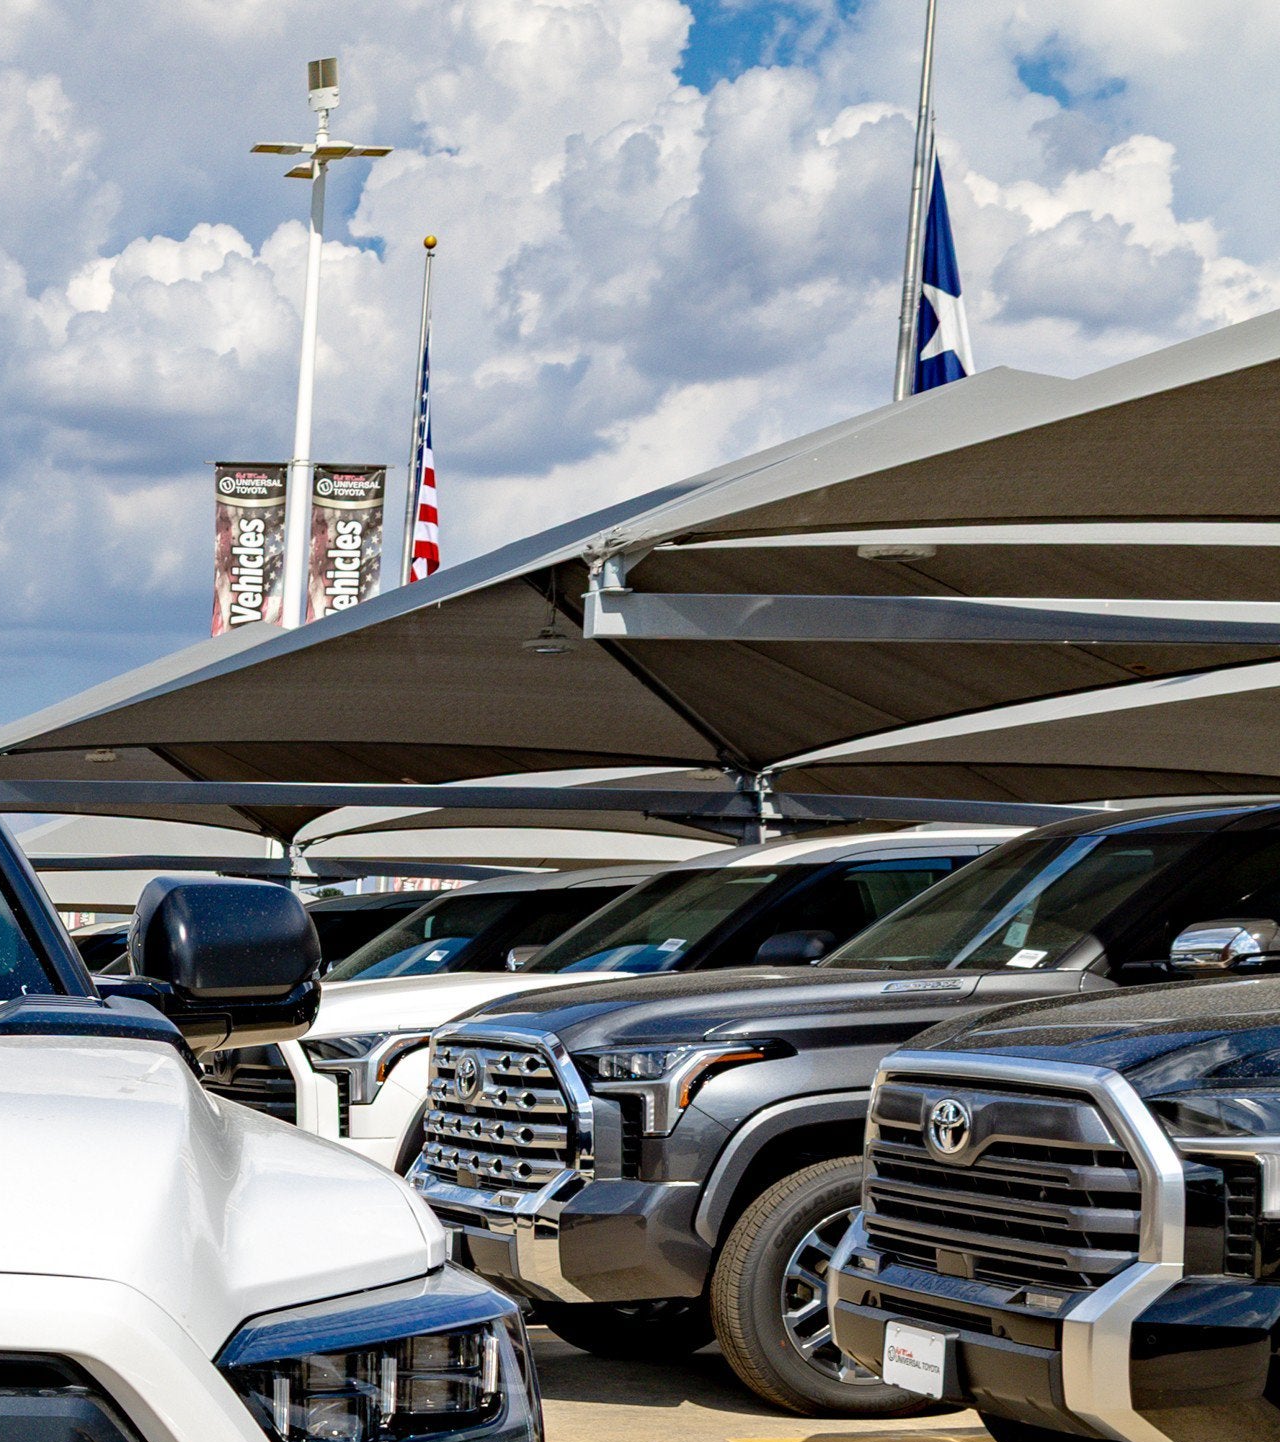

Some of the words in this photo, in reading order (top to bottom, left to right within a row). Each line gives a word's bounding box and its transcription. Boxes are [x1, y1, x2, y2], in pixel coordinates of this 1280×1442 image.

[235, 479, 283, 487] UNIVERSAL
[333, 481, 381, 489] UNIVERSAL
[236, 486, 268, 495] TOYOTA
[333, 488, 366, 497] TOYOTA
[230, 518, 265, 625] Vehicles
[894, 1356, 921, 1370] UNIVERSAL
[922, 1361, 941, 1374] TOYOTA
